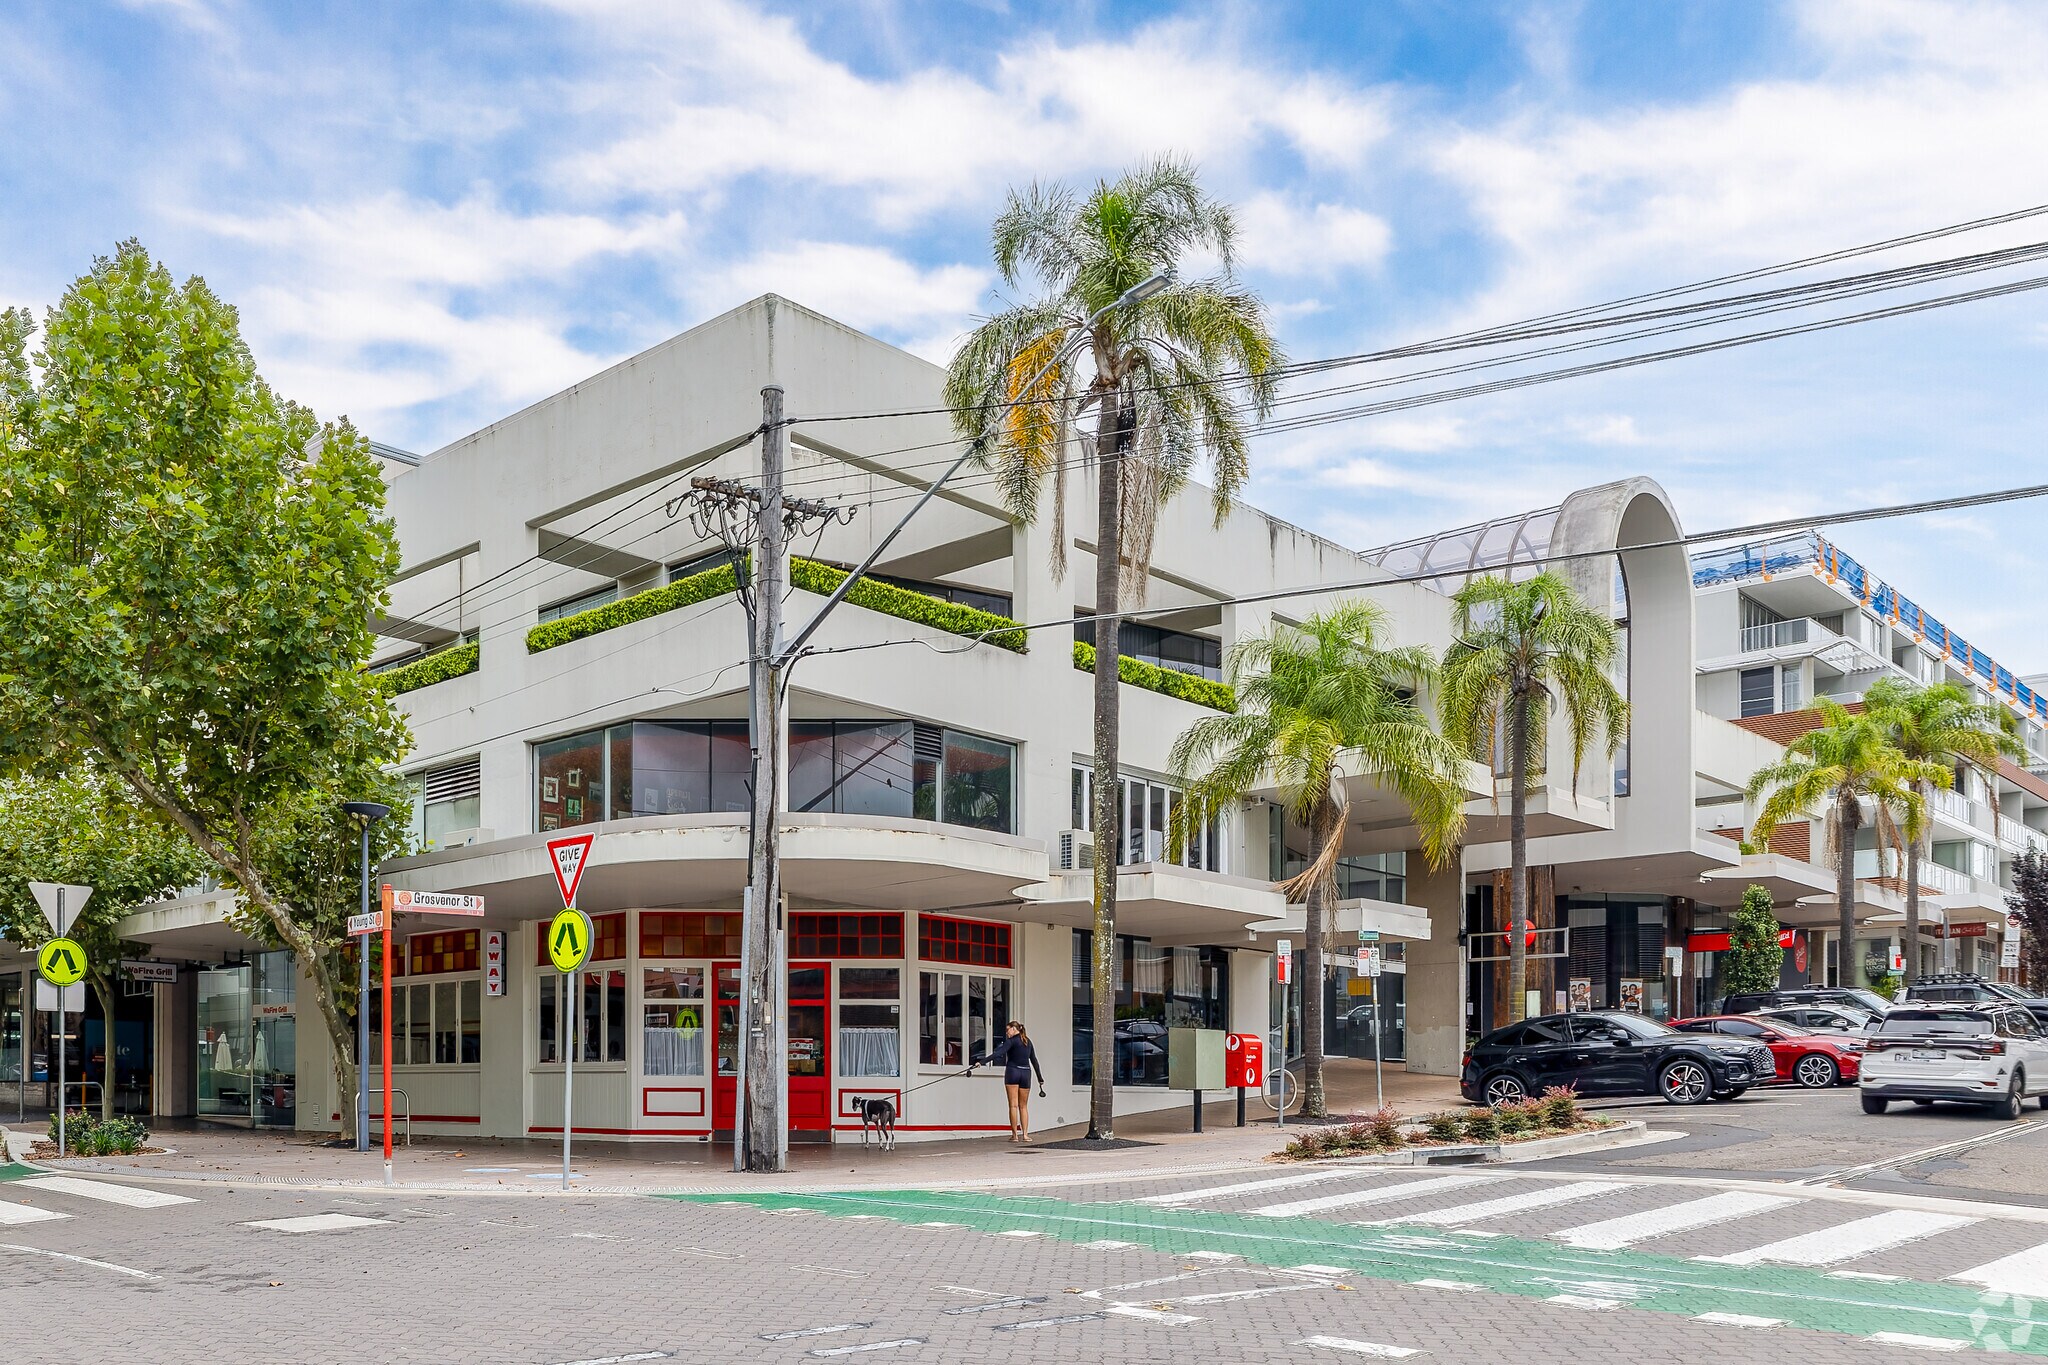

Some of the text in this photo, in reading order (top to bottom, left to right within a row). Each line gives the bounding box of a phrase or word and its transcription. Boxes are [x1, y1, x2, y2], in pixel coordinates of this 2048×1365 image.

[559, 847, 580, 863] GIVE
[562, 862, 578, 874] WAY
[414, 892, 473, 907] Grosvenor St
[353, 913, 375, 928] Young St
[125, 966, 173, 976] WaFire Grill
[488, 935, 500, 992] AWAY
